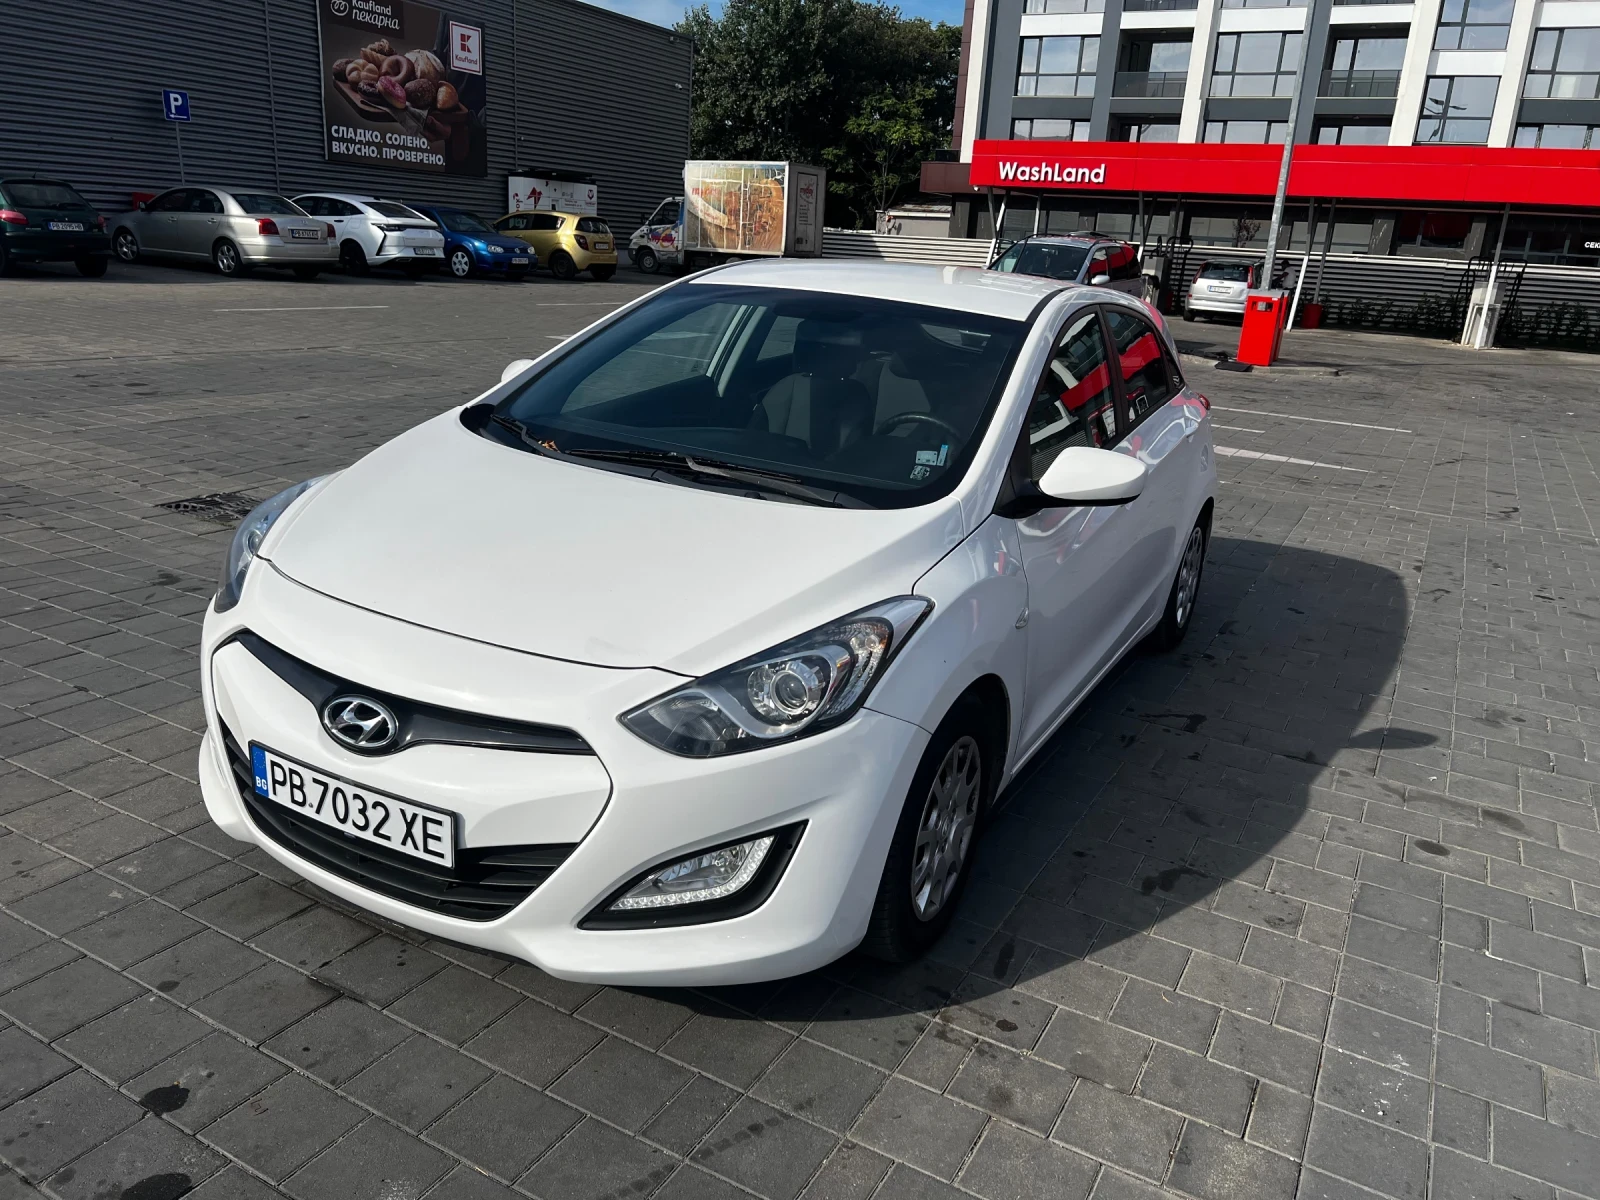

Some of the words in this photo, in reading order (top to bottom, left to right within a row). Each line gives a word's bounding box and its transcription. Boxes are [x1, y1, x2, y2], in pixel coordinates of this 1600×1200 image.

[352, 0, 391, 15] Kaufland
[352, 9, 400, 29] пекарна
[455, 54, 478, 65] Kaufland
[169, 93, 183, 114] P
[331, 125, 383, 144] СЛАДКО.
[385, 132, 430, 150] СОЛЕНО.
[332, 141, 380, 158] ВКУСНО.
[382, 147, 446, 166] ПРОВЕРЕНО.
[999, 162, 1106, 183] WashLand
[255, 776, 268, 791] BG
[399, 807, 446, 860] XE
